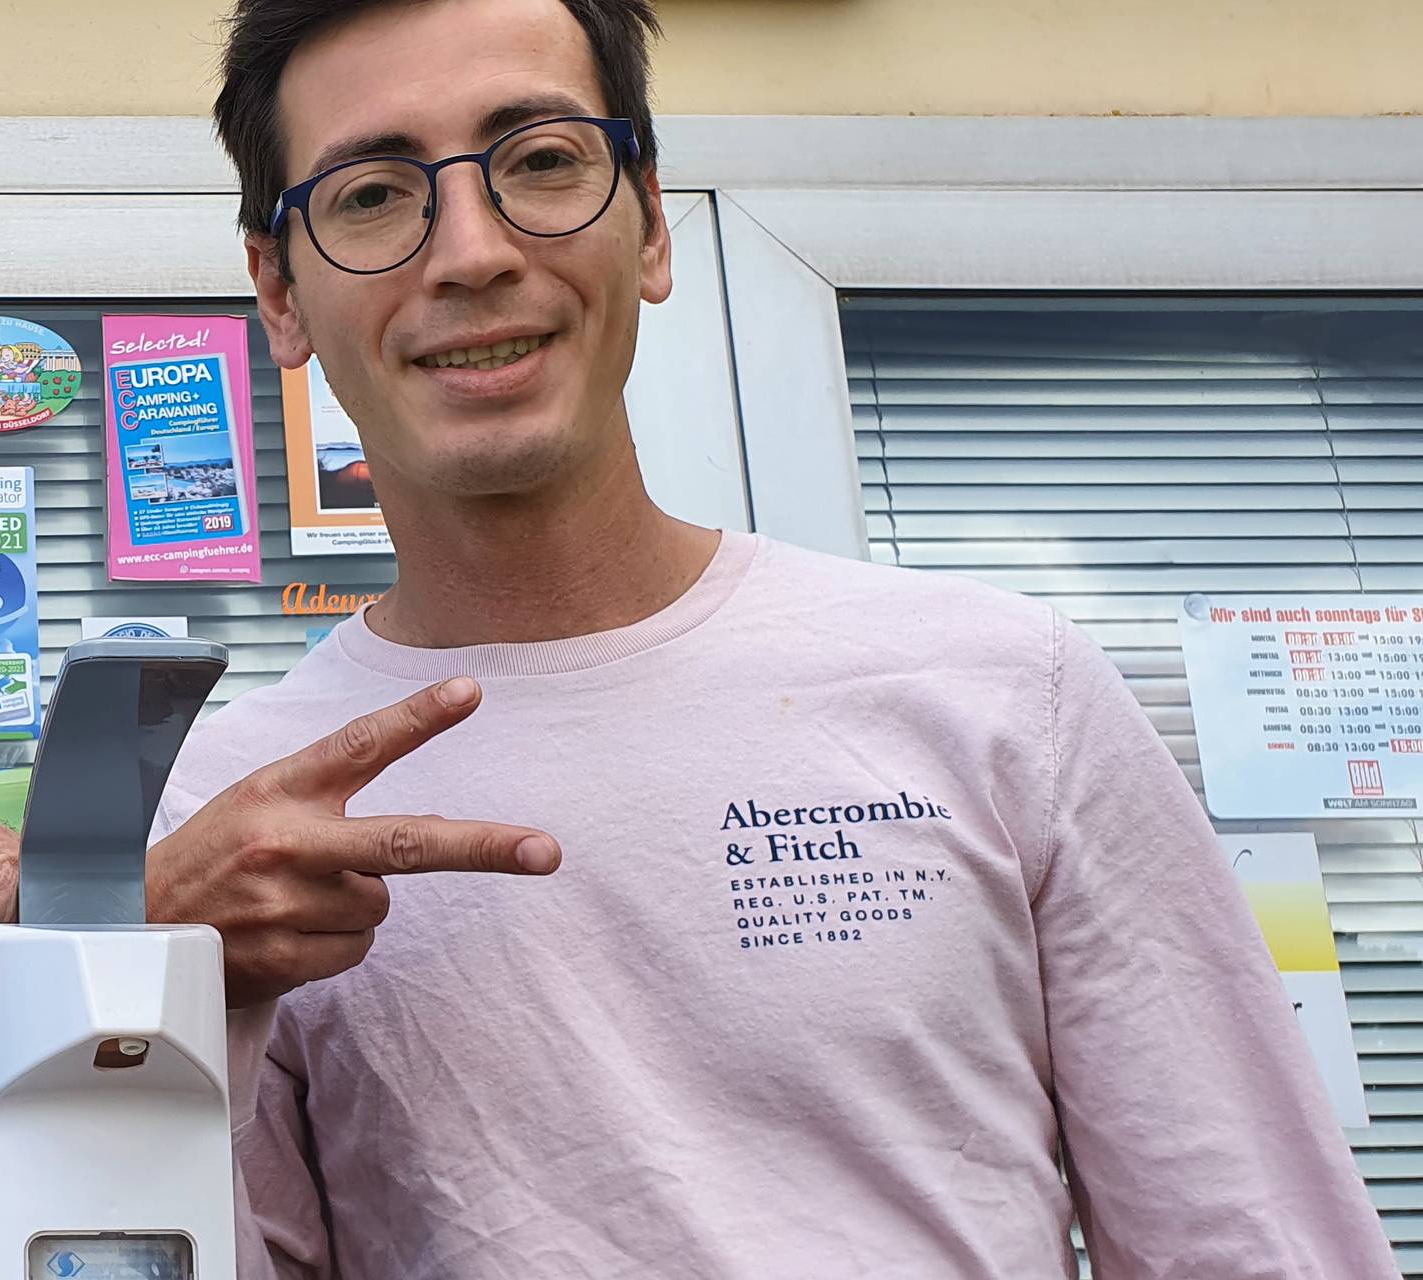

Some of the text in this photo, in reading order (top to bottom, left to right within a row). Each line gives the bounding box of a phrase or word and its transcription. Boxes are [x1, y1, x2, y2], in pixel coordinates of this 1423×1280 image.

[1, 318, 13, 326] ZU
[115, 363, 213, 390] EUROPA
[2, 410, 51, 430] DÜSSELDORF
[121, 402, 218, 431] CARAVANING
[204, 515, 232, 530] 2019
[117, 543, 253, 565] www.ecc-campingfuehrer.de
[1210, 606, 1237, 623] Wir
[1241, 607, 1272, 623] sind
[1277, 606, 1311, 623] auch
[1315, 607, 1381, 624] sonntags
[1385, 606, 1408, 623] für
[720, 791, 952, 830] Abercrombie
[726, 829, 863, 866] & Fitch
[730, 869, 952, 891] ESTABLISHED IN N.Y.
[733, 888, 935, 911] REG. U.S. PAT. TM.
[737, 908, 913, 929] QUALITY GOODS
[740, 929, 863, 949] SINCE 1892
